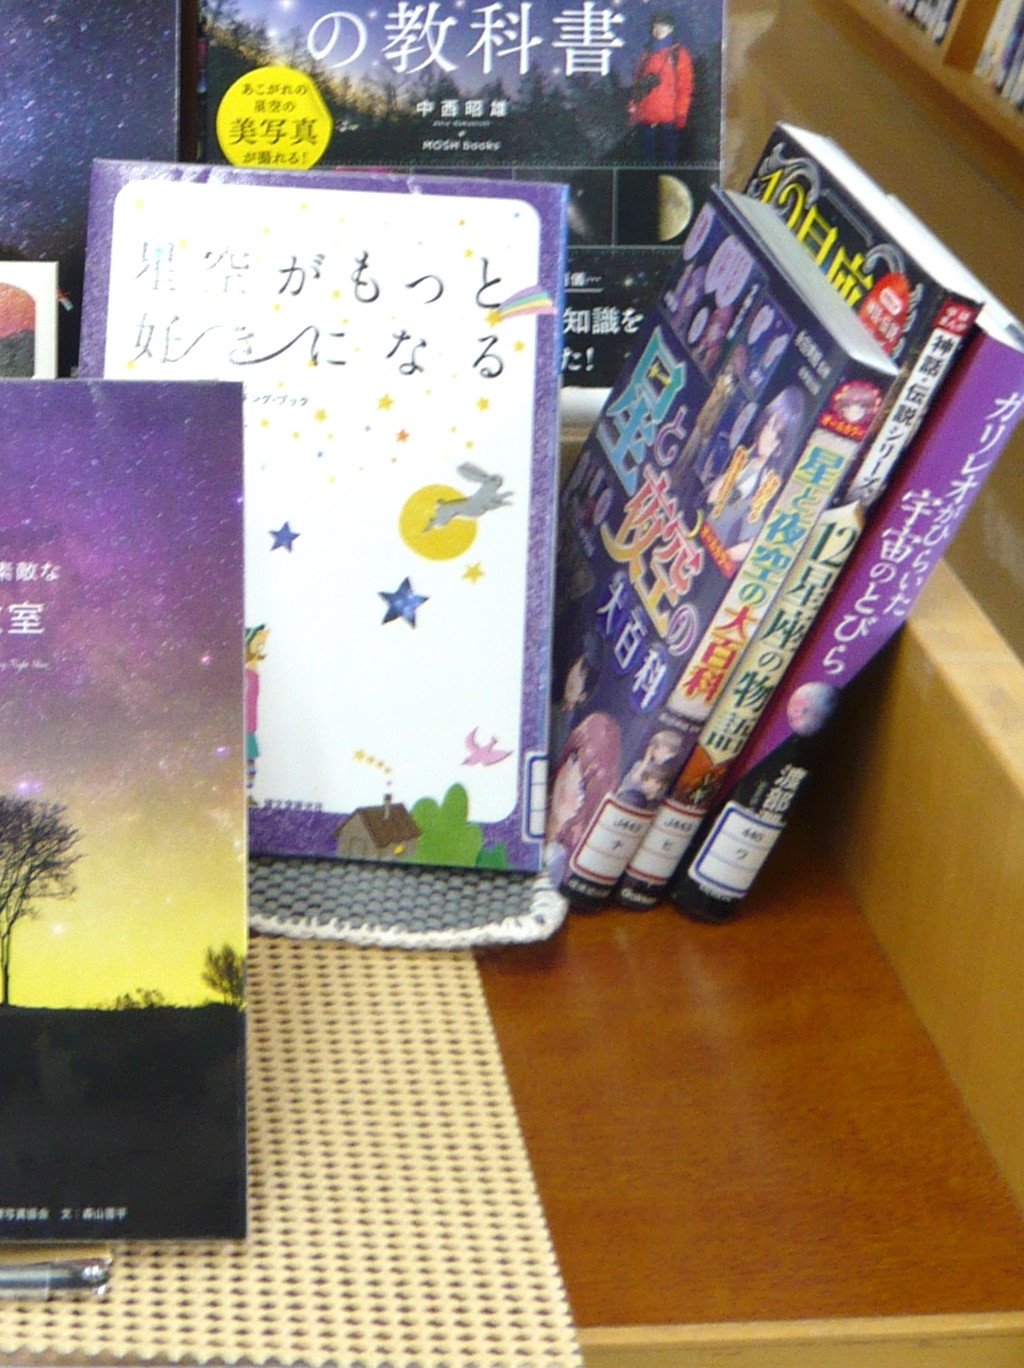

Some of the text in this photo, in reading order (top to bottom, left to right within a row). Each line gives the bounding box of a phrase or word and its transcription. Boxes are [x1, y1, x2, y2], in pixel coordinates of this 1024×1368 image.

[307, 0, 624, 76] の教科書
[242, 83, 307, 96] あこがれの
[416, 98, 509, 118] 中西昭雄
[229, 117, 318, 146] 美写真
[135, 240, 504, 309] 星空がもっと
[134, 312, 506, 379] 好きになる
[883, 391, 1024, 619] ガリレオがひらいた
[682, 444, 848, 703] 星と夜空の大百科
[822, 487, 943, 676] 宇宙のとびら
[597, 580, 668, 710] 大百科
[706, 522, 857, 753] 12星座の物語
